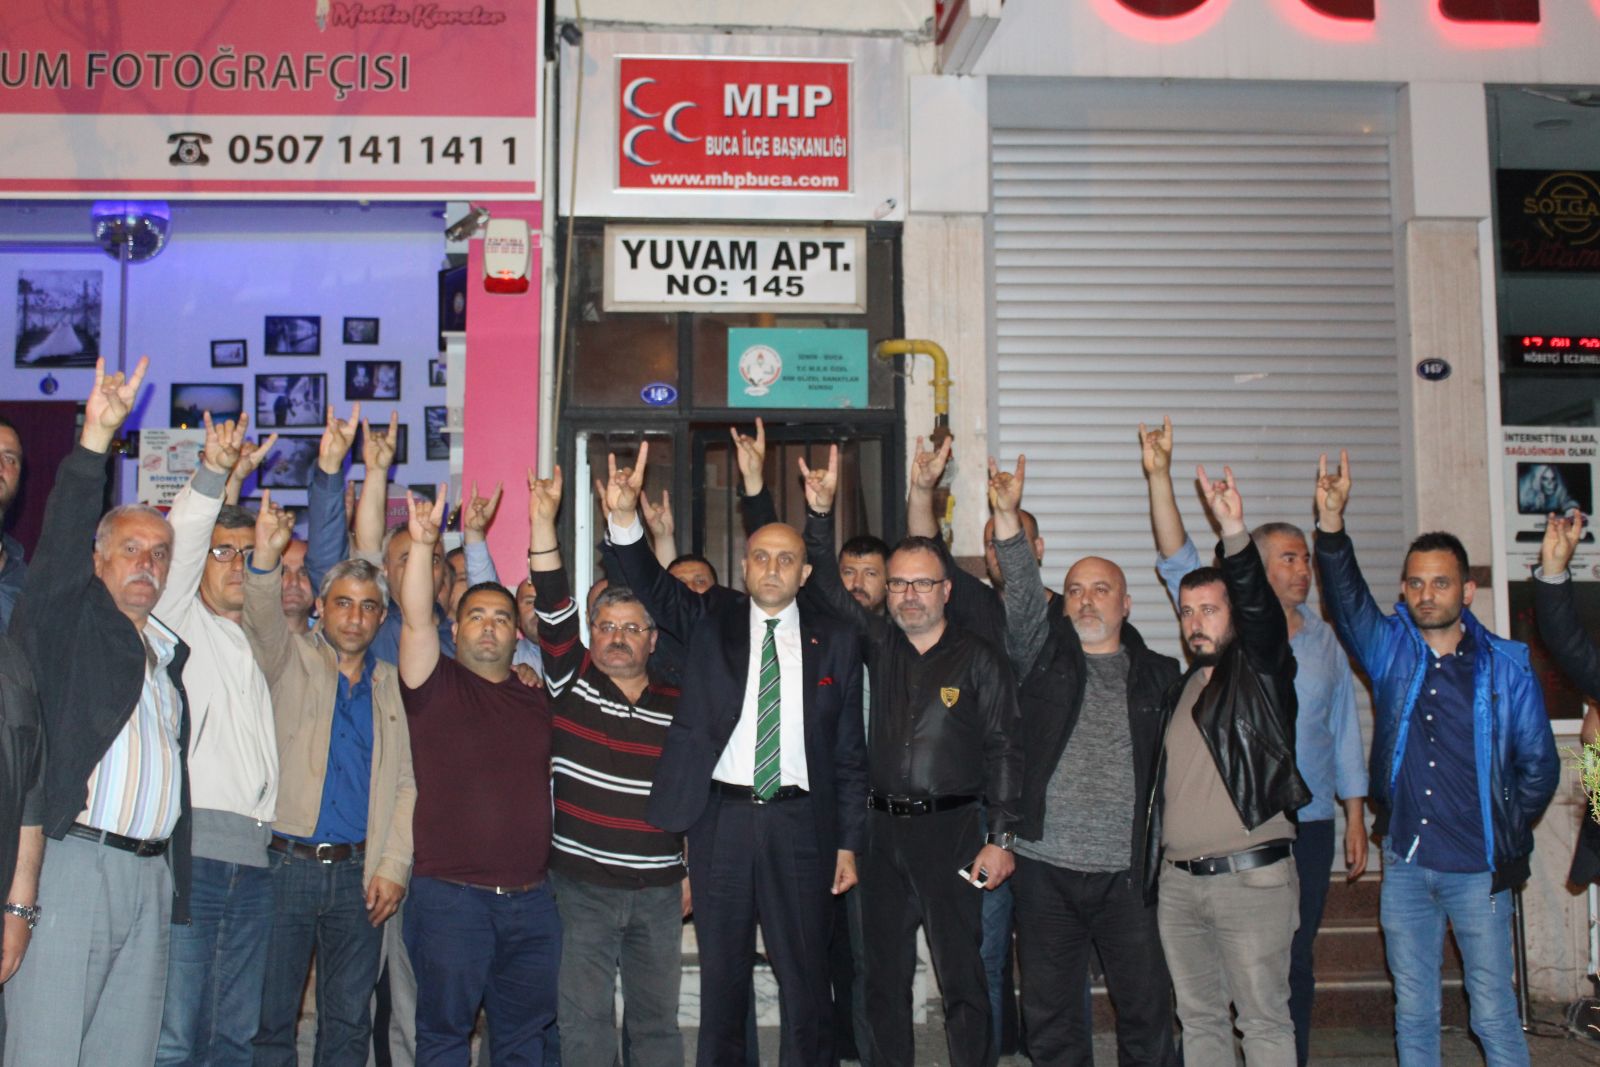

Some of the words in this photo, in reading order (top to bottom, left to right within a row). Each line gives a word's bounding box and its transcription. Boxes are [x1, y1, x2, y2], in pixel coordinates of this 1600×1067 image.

[0, 51, 69, 89] UM
[86, 46, 410, 99] FOTOĞRAFÇISI
[724, 83, 833, 117] MHP
[227, 134, 325, 165] 0507
[337, 135, 401, 165] 141
[705, 135, 740, 156] BUCA
[742, 129, 770, 159] İLÇE
[772, 134, 847, 159] BAŞKANLIĞI
[650, 171, 840, 189] www.mhpbuca.com
[621, 239, 758, 270] YUVAM
[771, 241, 851, 272] APT.
[666, 274, 729, 296] NO:
[742, 275, 805, 297] 145
